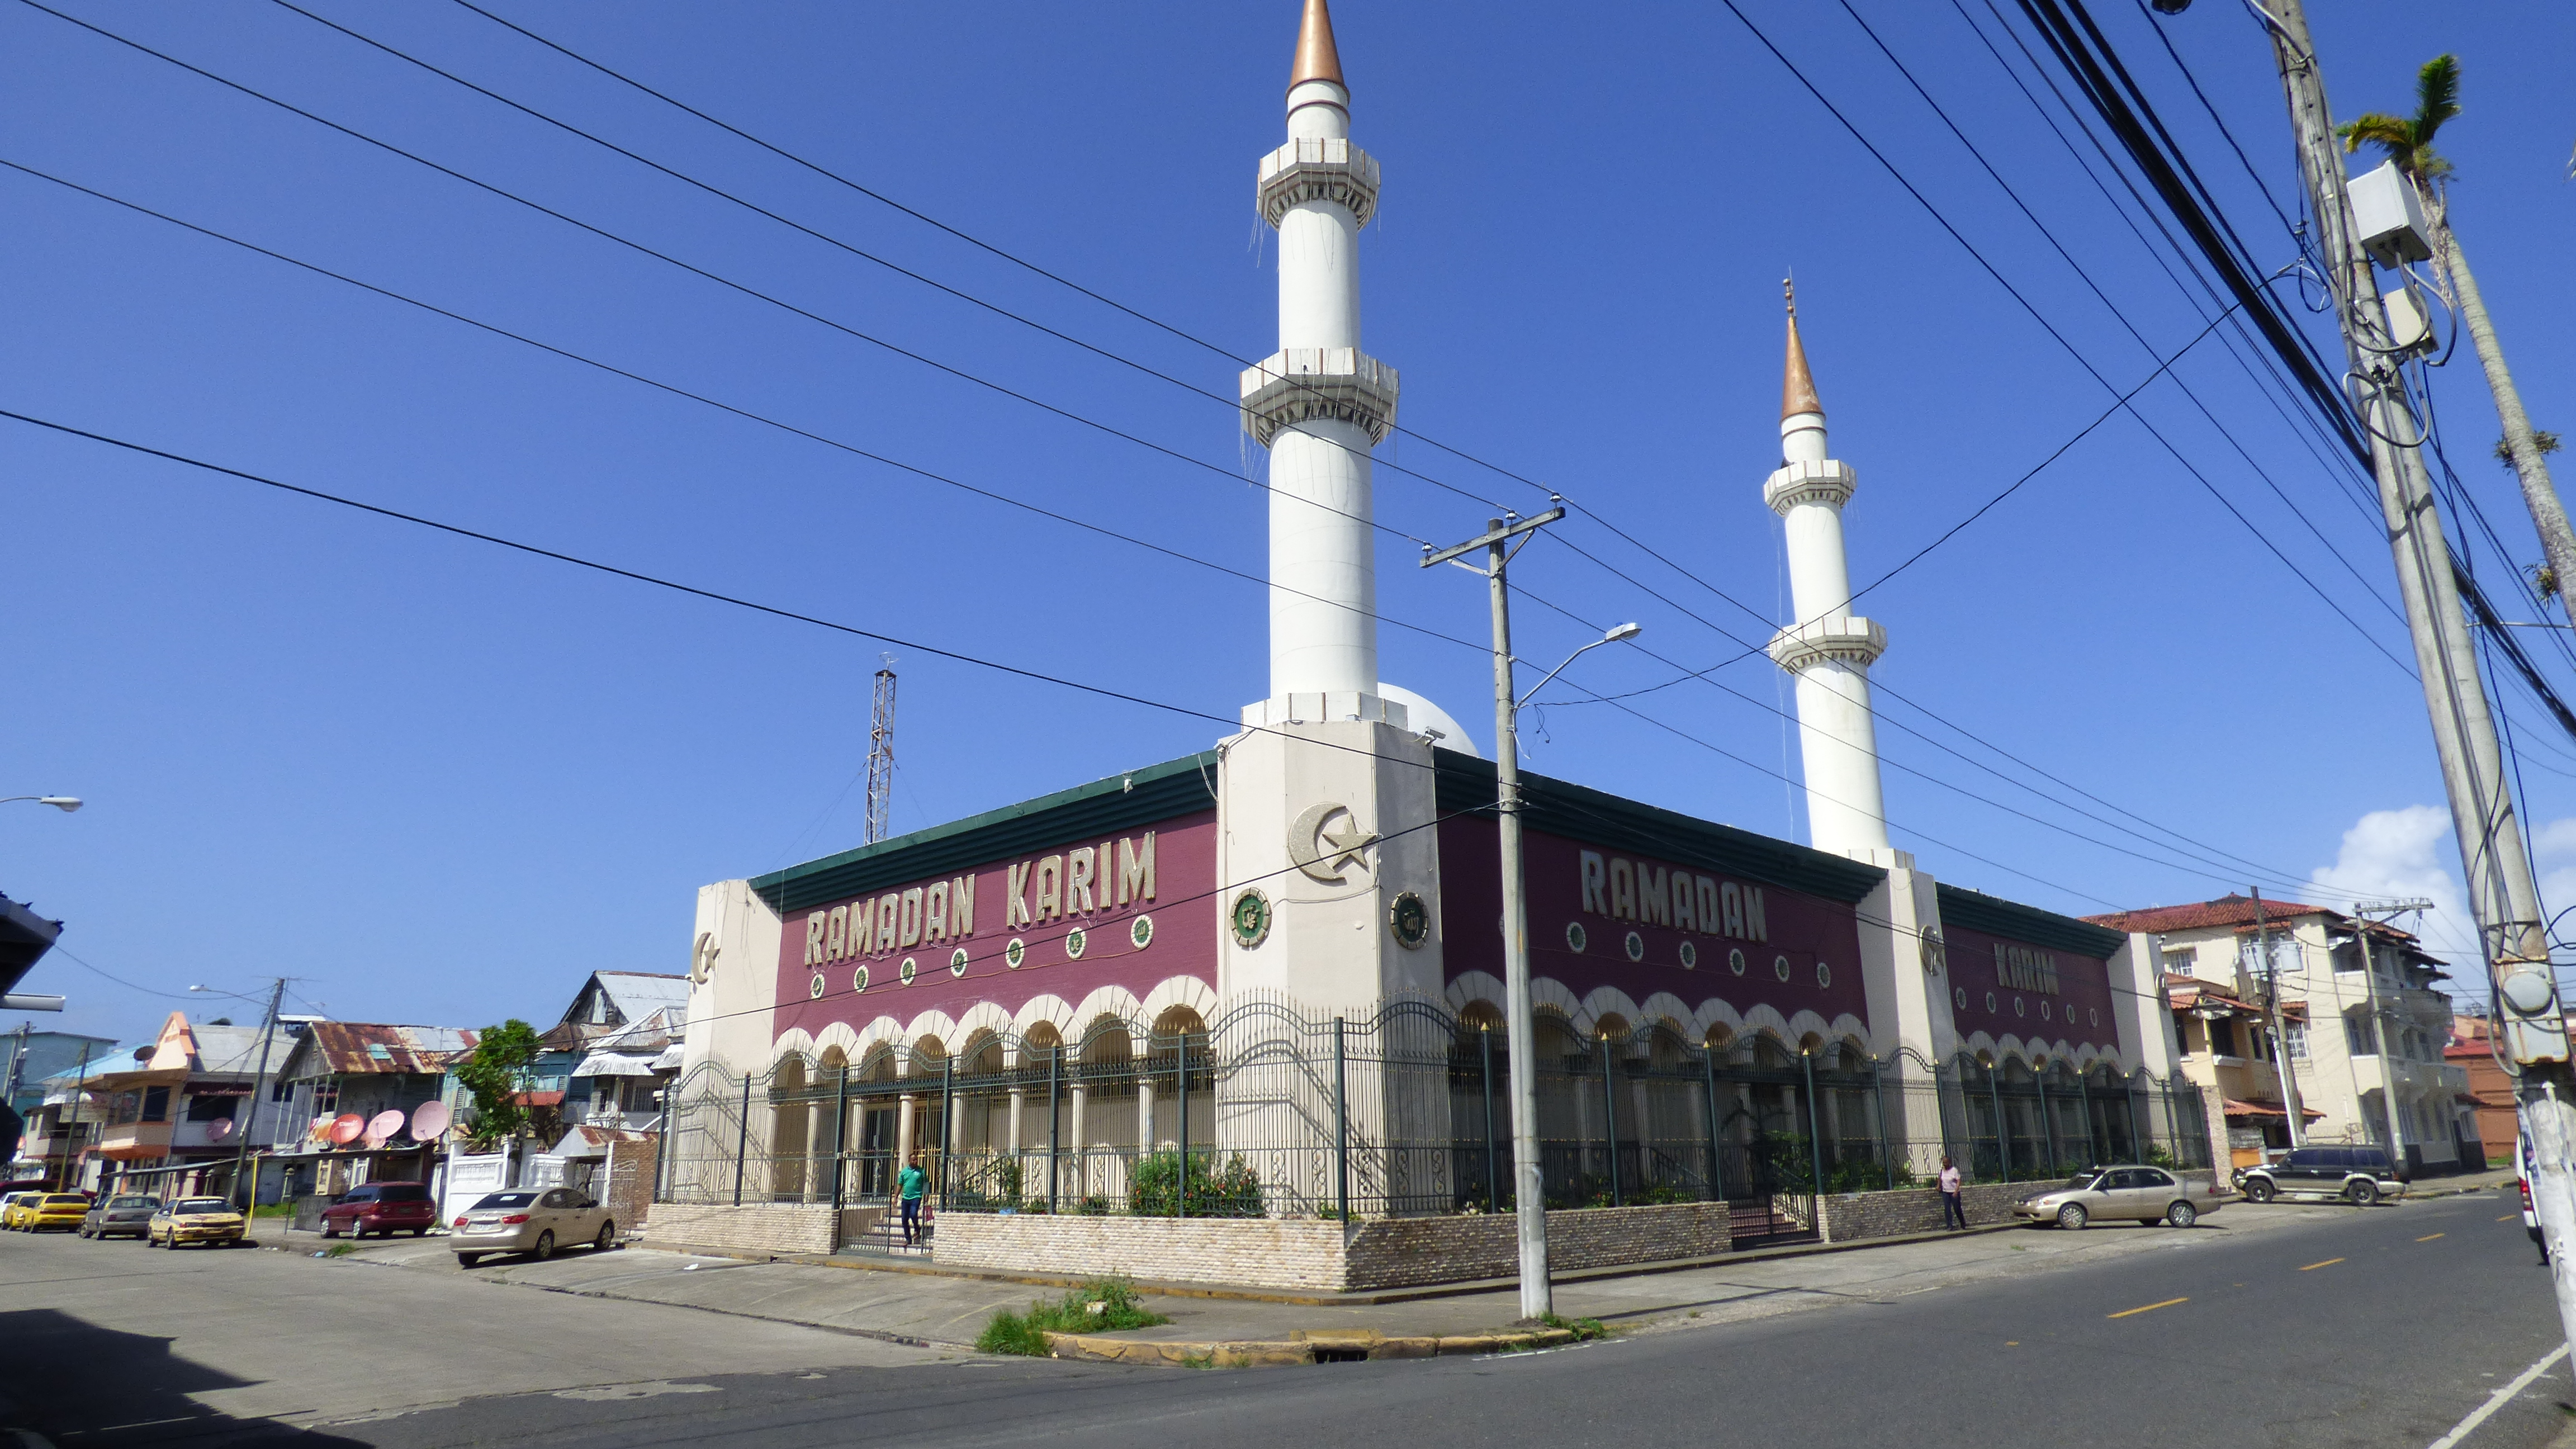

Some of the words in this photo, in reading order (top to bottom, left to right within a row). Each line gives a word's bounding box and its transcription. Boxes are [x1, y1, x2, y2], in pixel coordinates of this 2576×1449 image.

[804, 873, 975, 965] RAMADAN
[1007, 831, 1157, 927] KARIM
[1580, 849, 1768, 943] RAMADAN
[1994, 943, 2059, 996] KARIM
